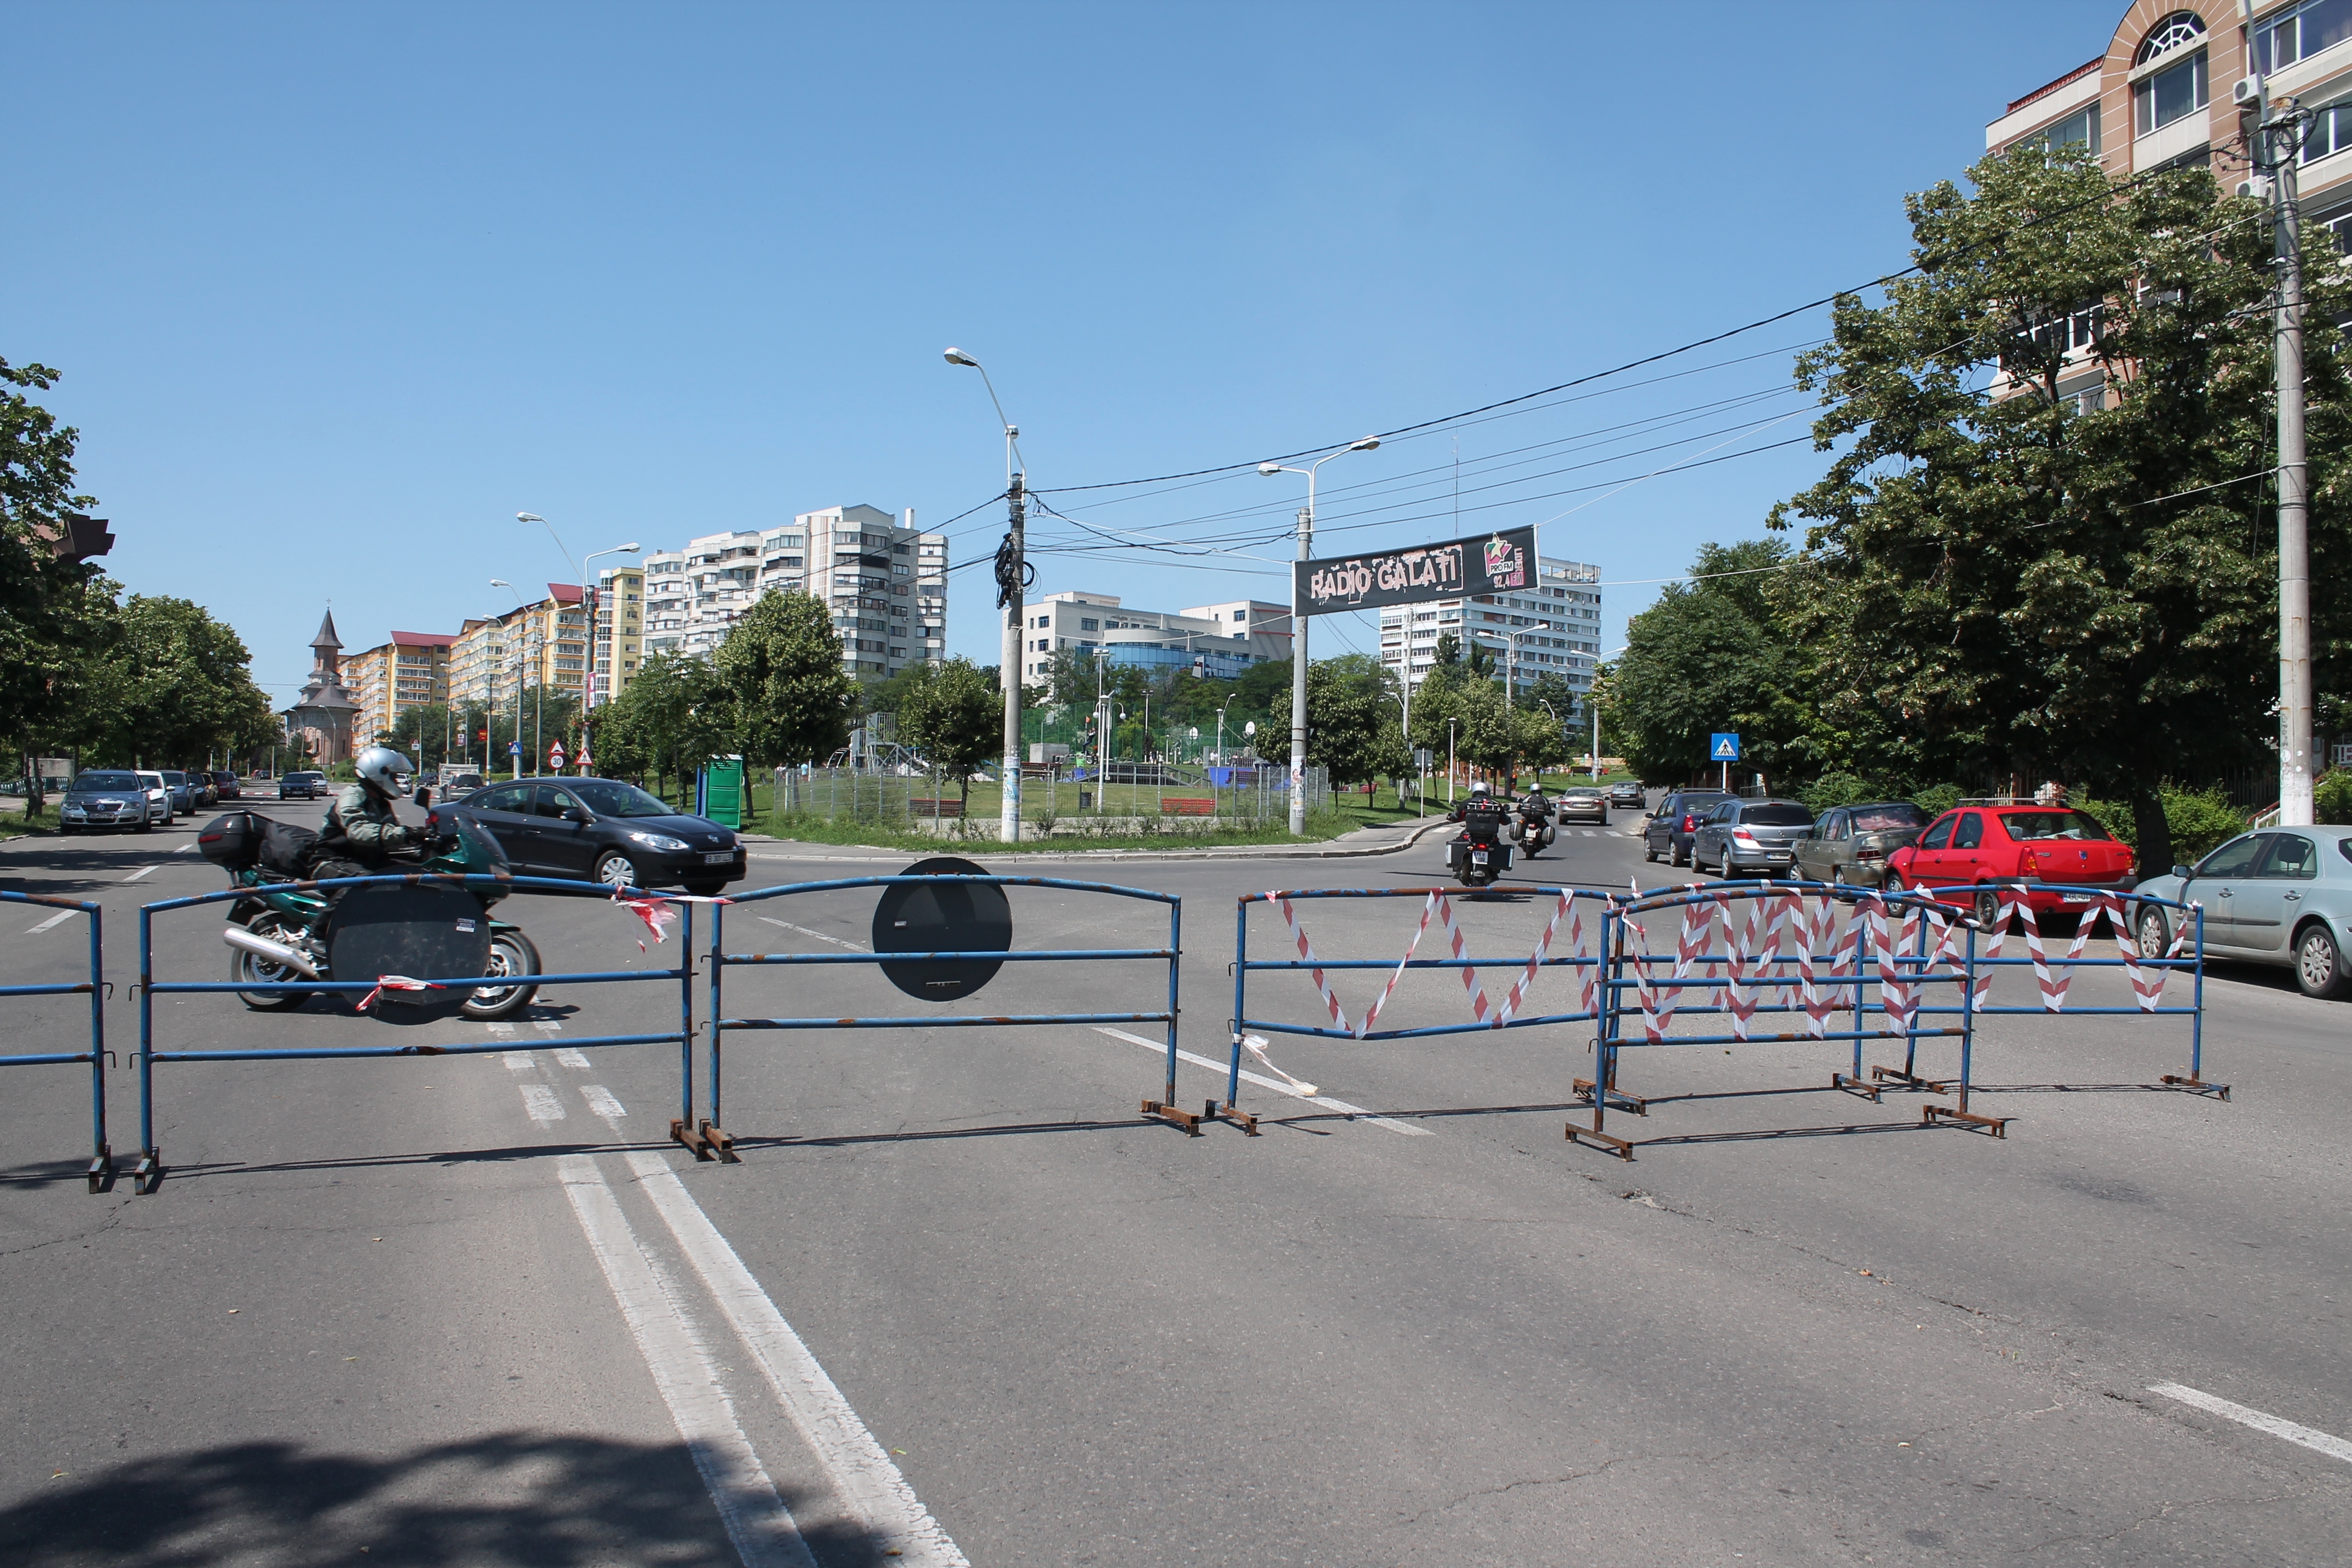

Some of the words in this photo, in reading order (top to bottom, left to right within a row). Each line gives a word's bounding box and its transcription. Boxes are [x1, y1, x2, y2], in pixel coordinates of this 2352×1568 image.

[1504, 562, 1512, 570] FM
[1514, 548, 1523, 571] LIDER
[1310, 567, 1371, 599] RADIO
[1378, 555, 1456, 590] GALATI
[1493, 574, 1510, 589] 92,4
[1512, 572, 1523, 585] FM
